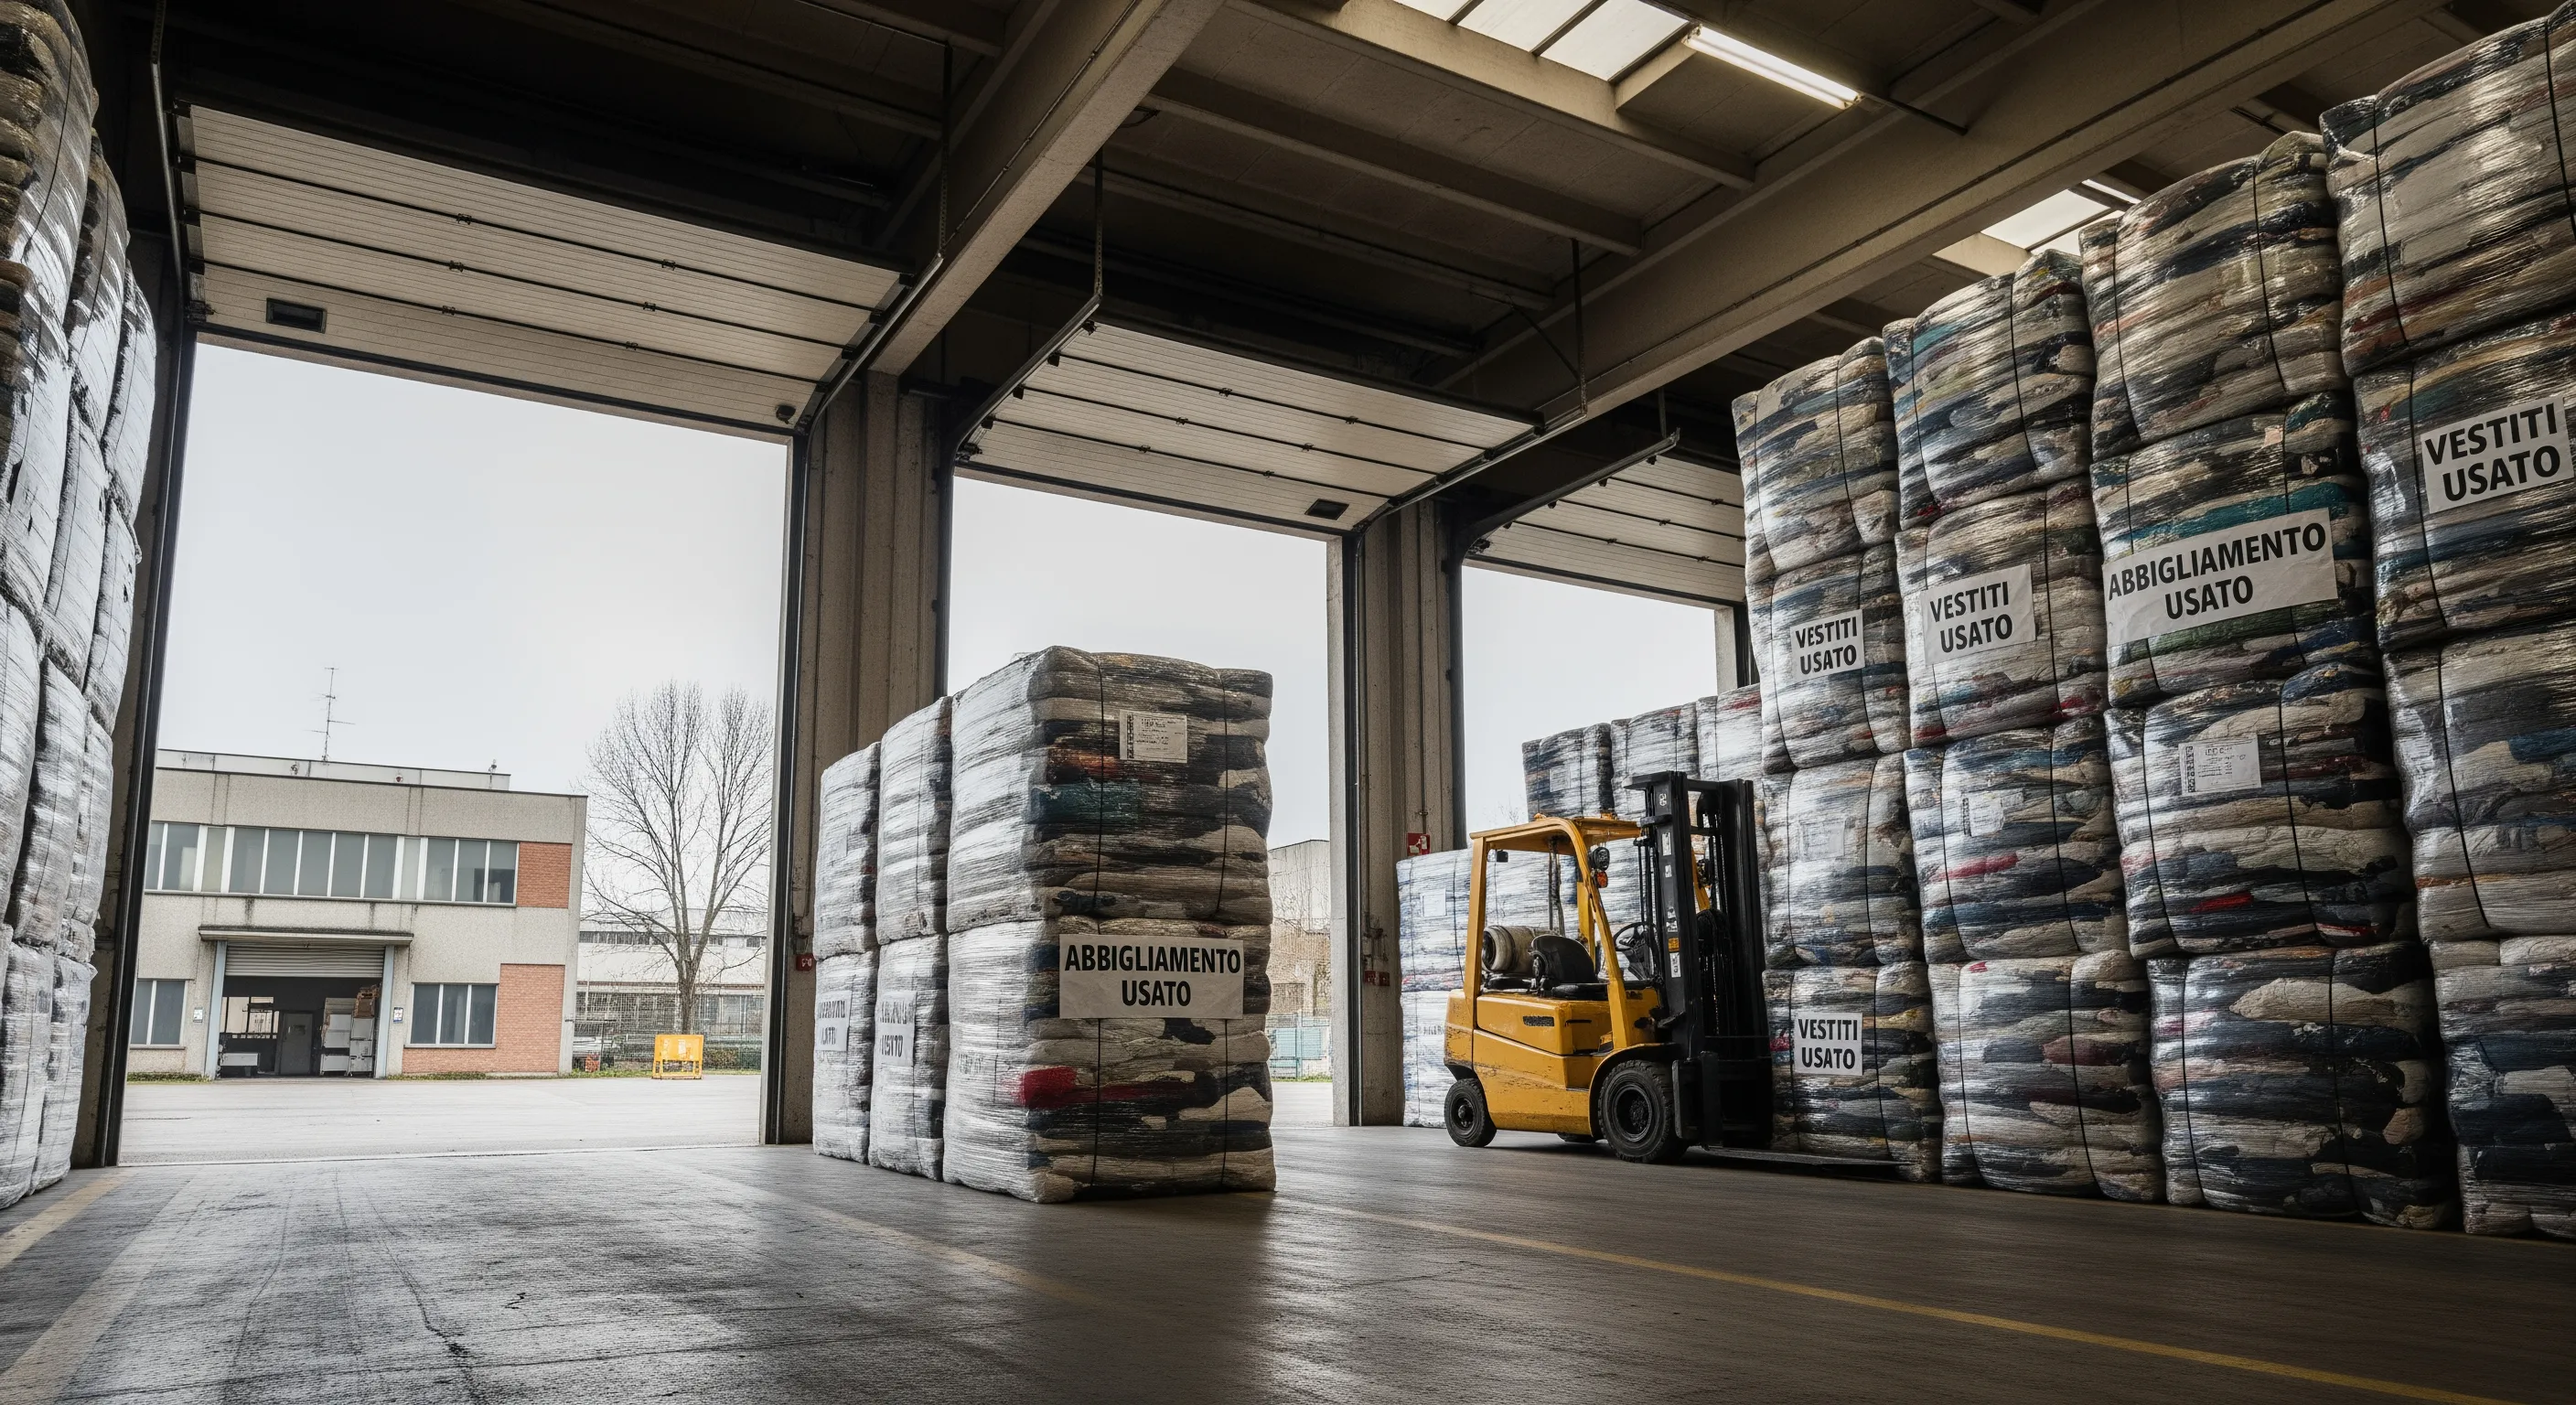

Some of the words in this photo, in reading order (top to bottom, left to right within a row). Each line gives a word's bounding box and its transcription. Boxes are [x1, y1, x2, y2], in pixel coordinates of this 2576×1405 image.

[2424, 402, 2558, 466] VESTITI
[2442, 445, 2560, 501] USATO
[2109, 522, 2326, 601] ABBIGLIAMENTO
[1929, 581, 2009, 623] VESTITI
[2164, 575, 2254, 620] USATO
[1795, 617, 1858, 649] VESTITI
[1940, 614, 2012, 653] USATO
[1799, 645, 1857, 675] USATO
[1064, 944, 1241, 974] ABBIGLIAMENTO
[1122, 980, 1191, 1006] USATO
[1798, 1019, 1858, 1040] VESTITI
[1801, 1047, 1856, 1069] USATO
